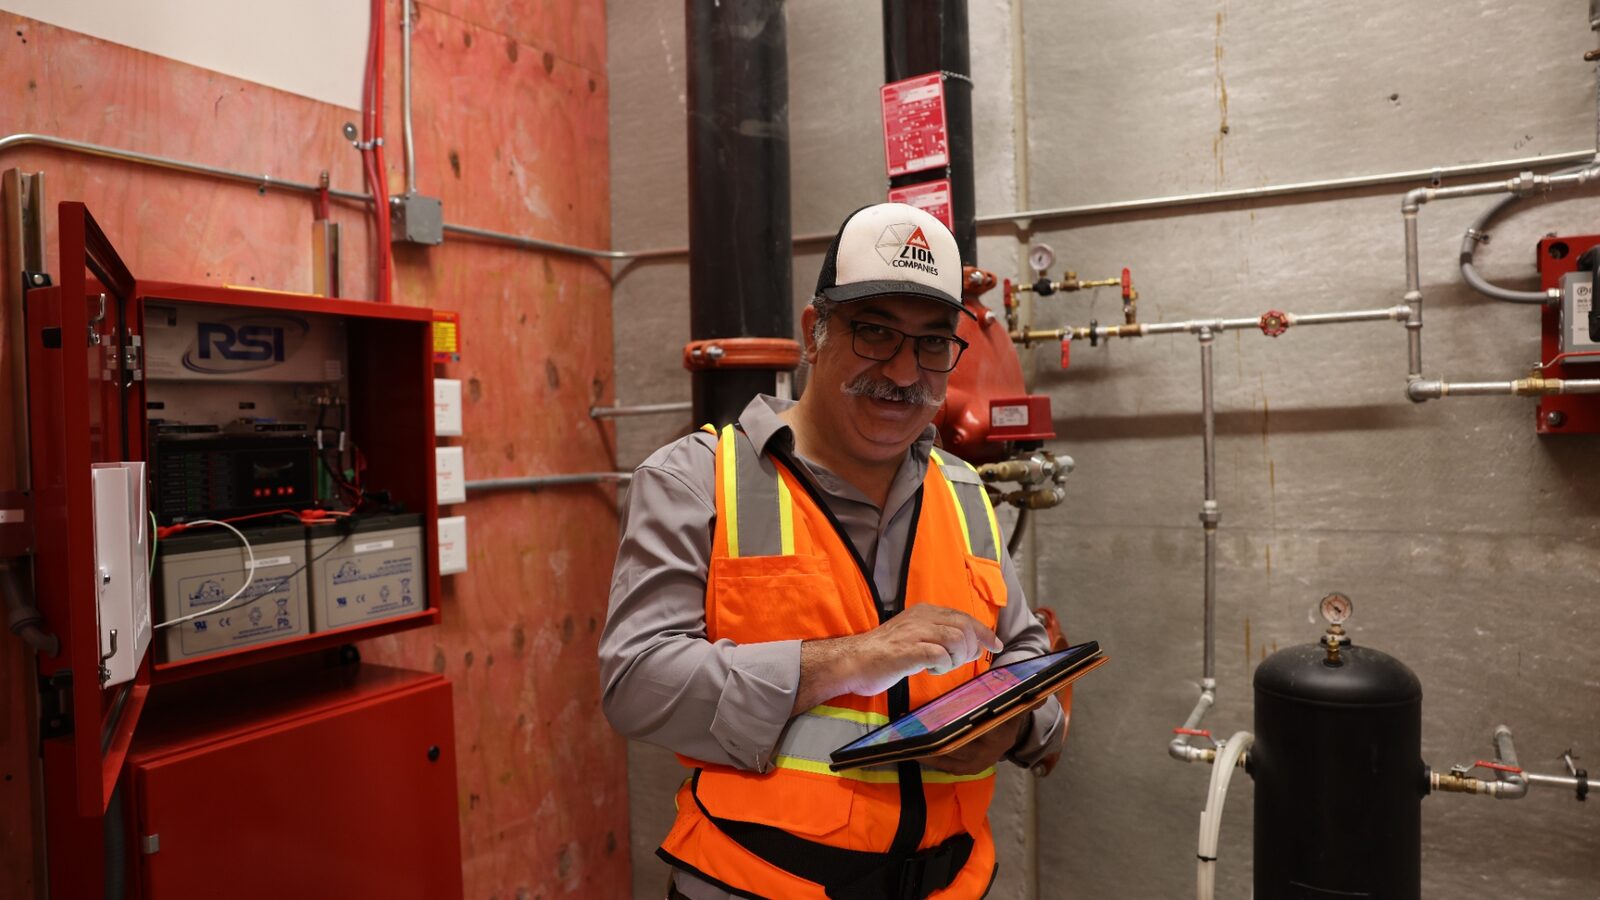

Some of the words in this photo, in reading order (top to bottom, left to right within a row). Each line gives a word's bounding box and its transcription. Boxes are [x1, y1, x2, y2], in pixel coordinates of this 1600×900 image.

[900, 246, 934, 264] ZION
[892, 259, 938, 276] COMPANIES
[197, 321, 285, 363] RSI
